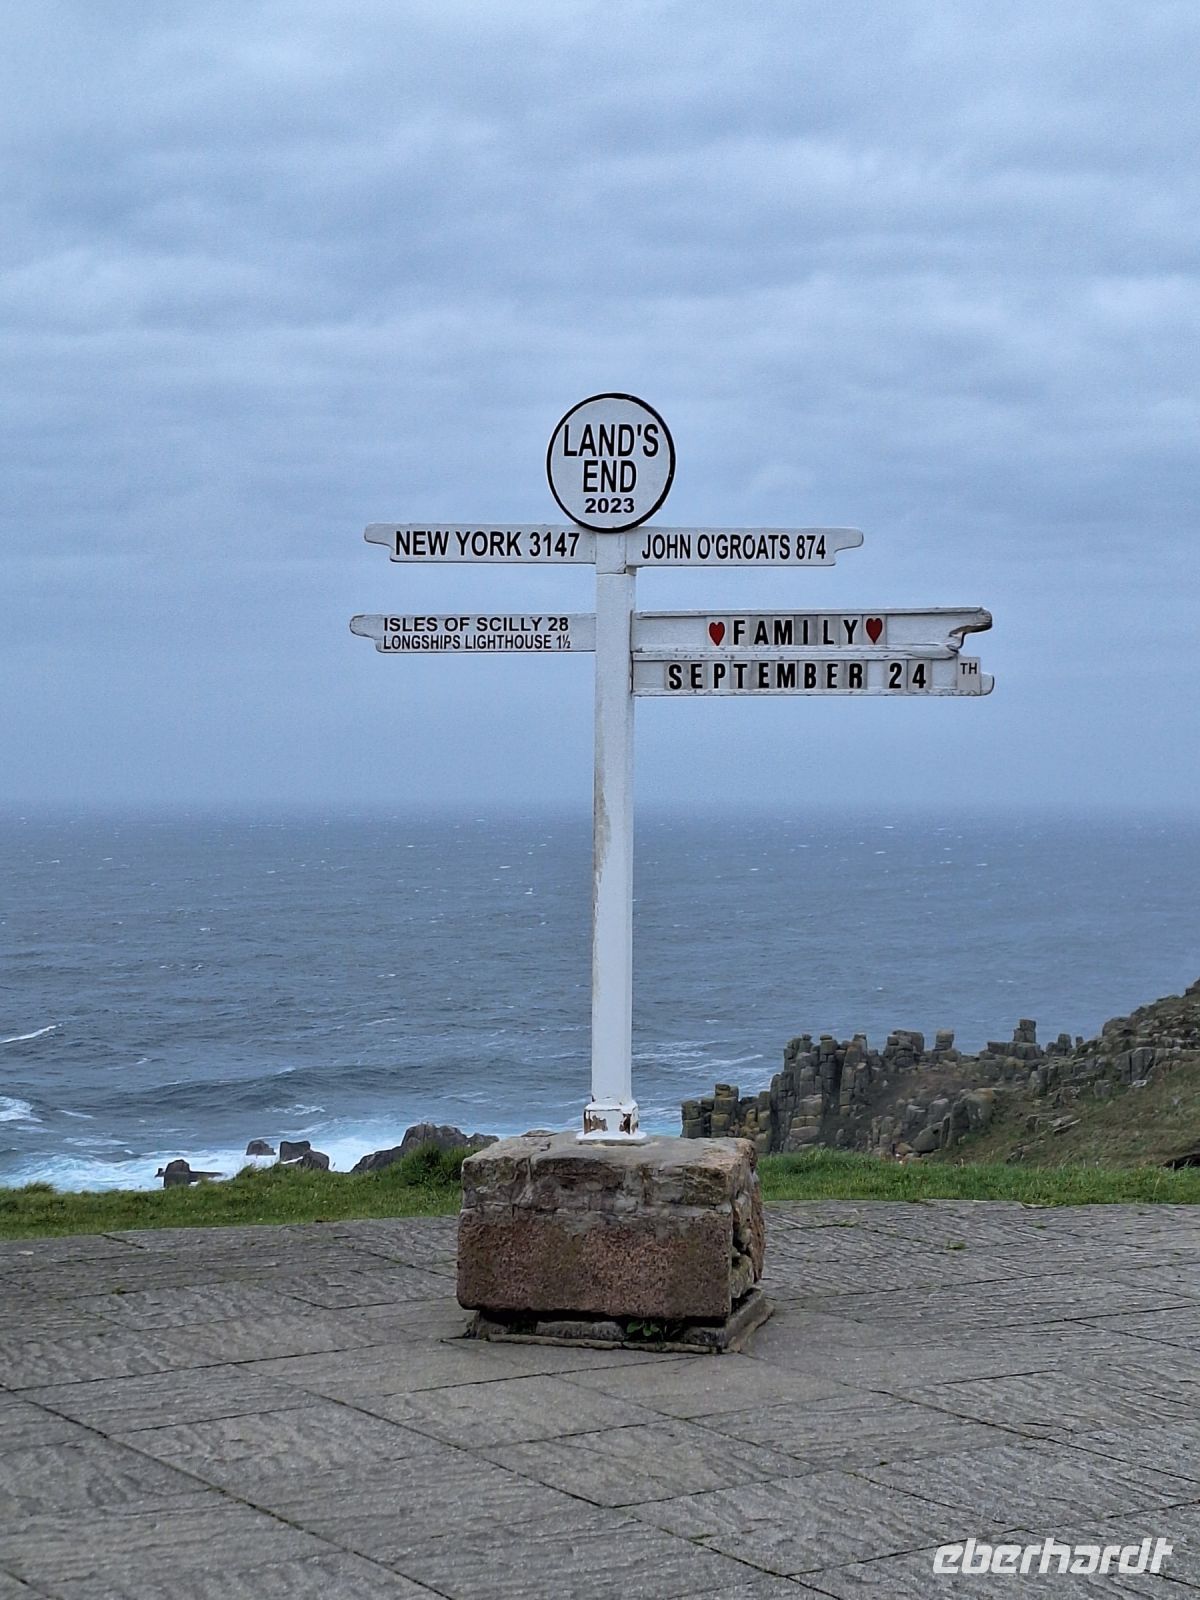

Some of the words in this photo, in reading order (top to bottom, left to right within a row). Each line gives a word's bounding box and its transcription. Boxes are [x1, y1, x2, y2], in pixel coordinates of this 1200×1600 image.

[563, 423, 659, 457] LAND'S
[583, 460, 637, 493] END
[585, 498, 635, 514] 2023
[395, 531, 449, 556] NEW
[455, 531, 522, 557] YORK
[529, 532, 580, 557] 3147
[642, 534, 691, 559] JOHN
[796, 535, 826, 559] 874
[384, 617, 438, 632] ISLES
[444, 617, 470, 632] OF
[476, 617, 542, 632] SCILLY
[548, 617, 569, 631] 28
[733, 620, 858, 645] FAMILY
[383, 635, 461, 649] LONGSHIPS
[465, 635, 551, 649] LIGHTHOUSE
[668, 662, 867, 689] SEPTEMBER
[889, 662, 926, 689] 24
[960, 662, 978, 675] TH
